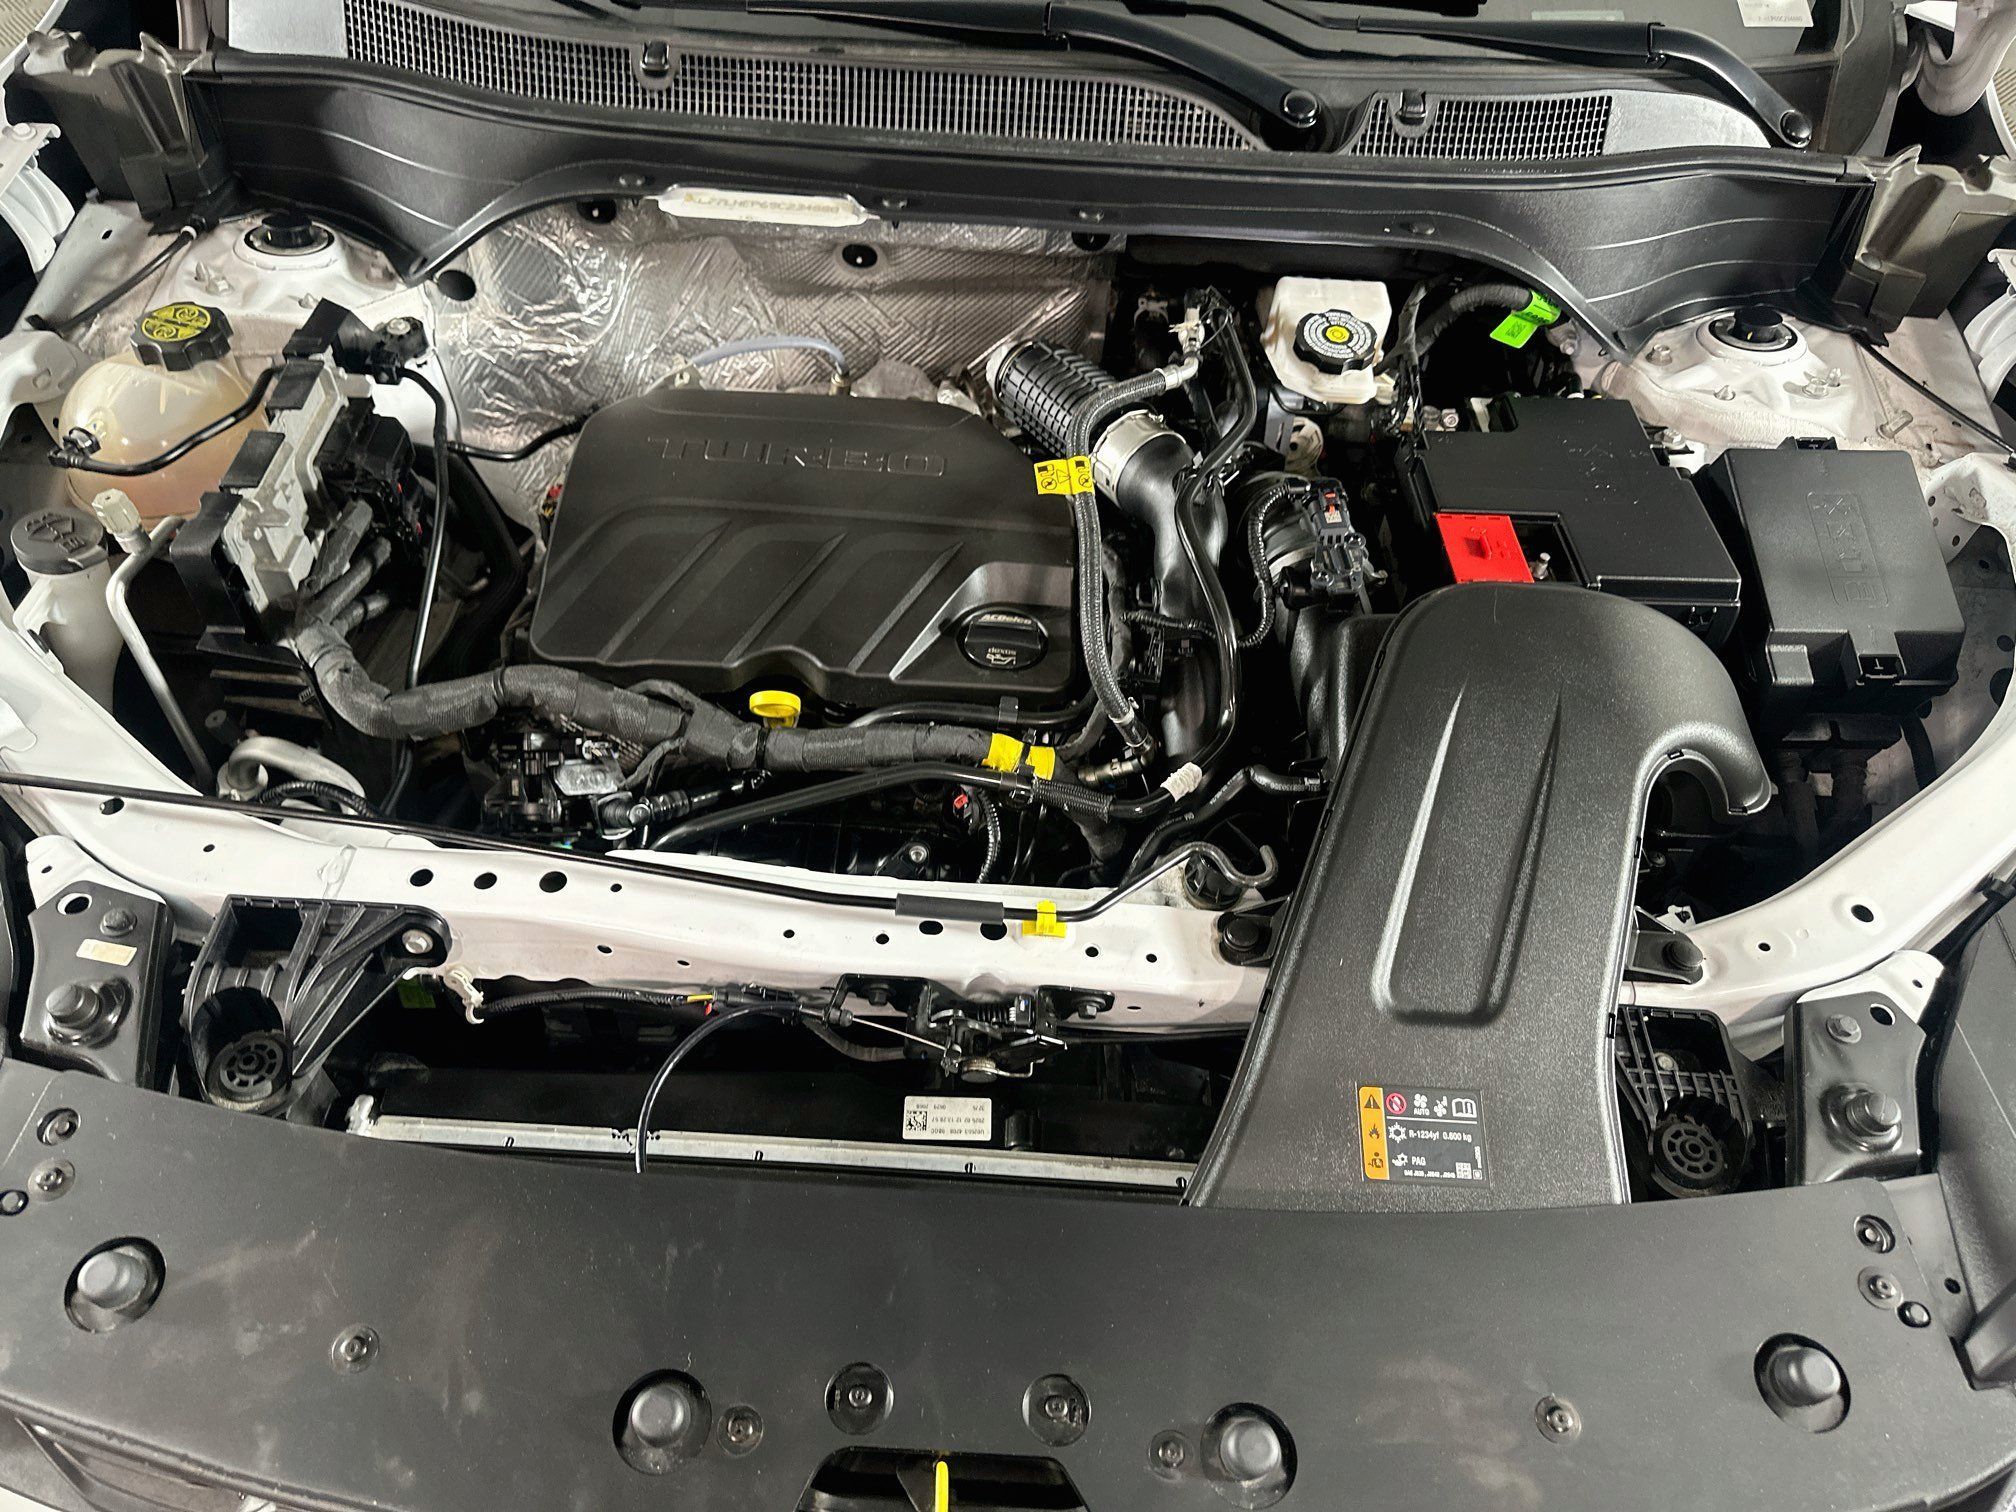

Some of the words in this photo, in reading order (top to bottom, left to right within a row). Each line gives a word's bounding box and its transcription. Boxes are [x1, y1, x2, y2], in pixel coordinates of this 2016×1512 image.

[647, 436, 947, 477] TURBO
[978, 613, 1032, 625] ACDelco
[1413, 1108, 1430, 1116] AUTO
[1409, 1130, 1440, 1141] R-1234yf
[1463, 1133, 1473, 1143] kg
[1412, 1156, 1427, 1166] PAG
